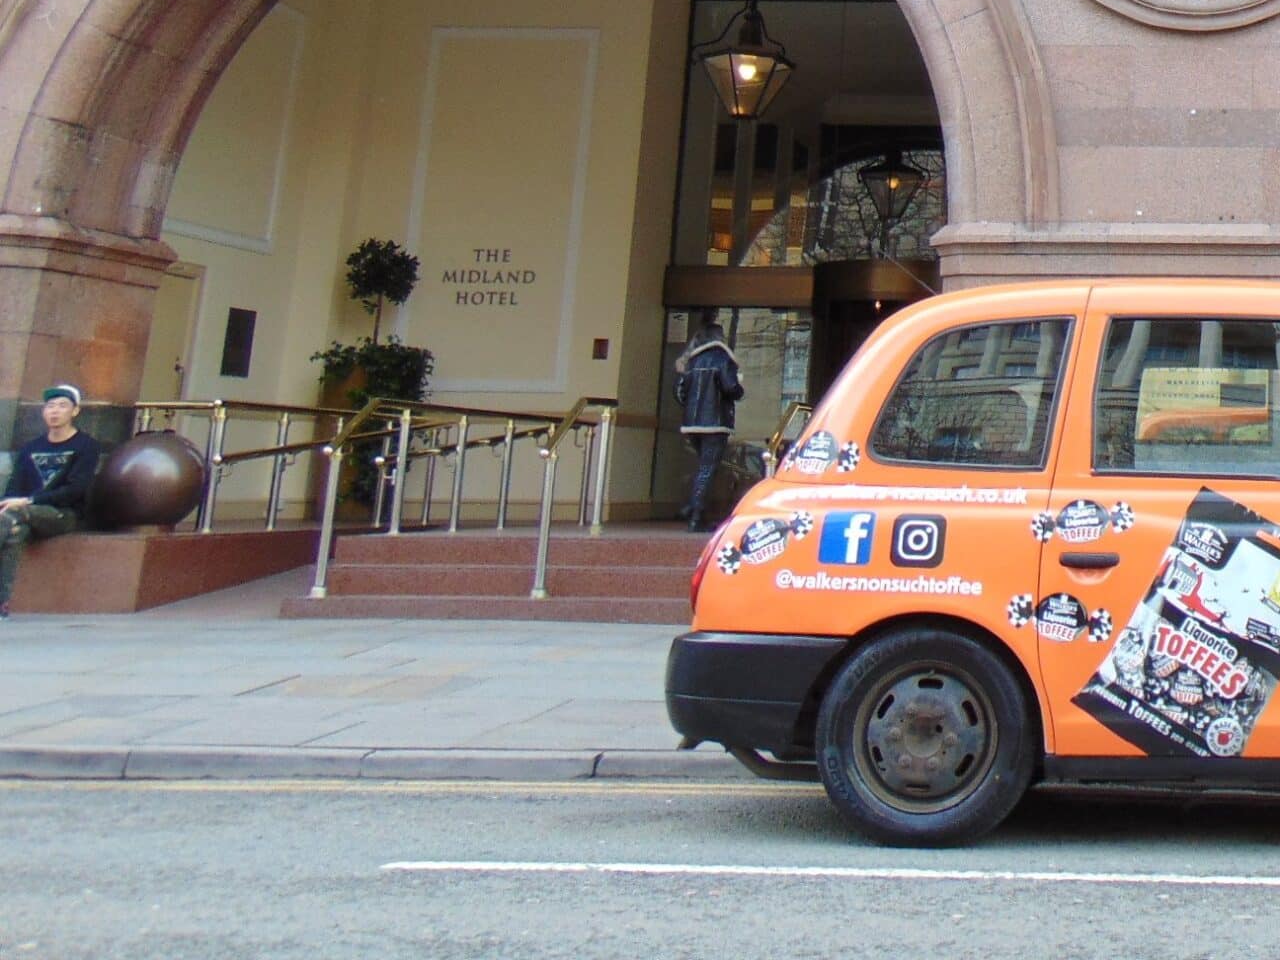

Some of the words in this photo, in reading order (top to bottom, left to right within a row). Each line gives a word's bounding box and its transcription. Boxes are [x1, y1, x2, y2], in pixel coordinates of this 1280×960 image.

[473, 248, 513, 263] THE
[442, 270, 537, 284] MIDLAND
[455, 291, 519, 306] HOTEL
[1063, 527, 1099, 540] TOFFEE
[776, 570, 983, 596] @walkersnonsuchtoffee
[1040, 624, 1074, 640] TOFFEE
[1183, 619, 1236, 660] Liquorice
[1156, 626, 1246, 696] TOFFEES
[1128, 699, 1172, 737] TOFFEES
